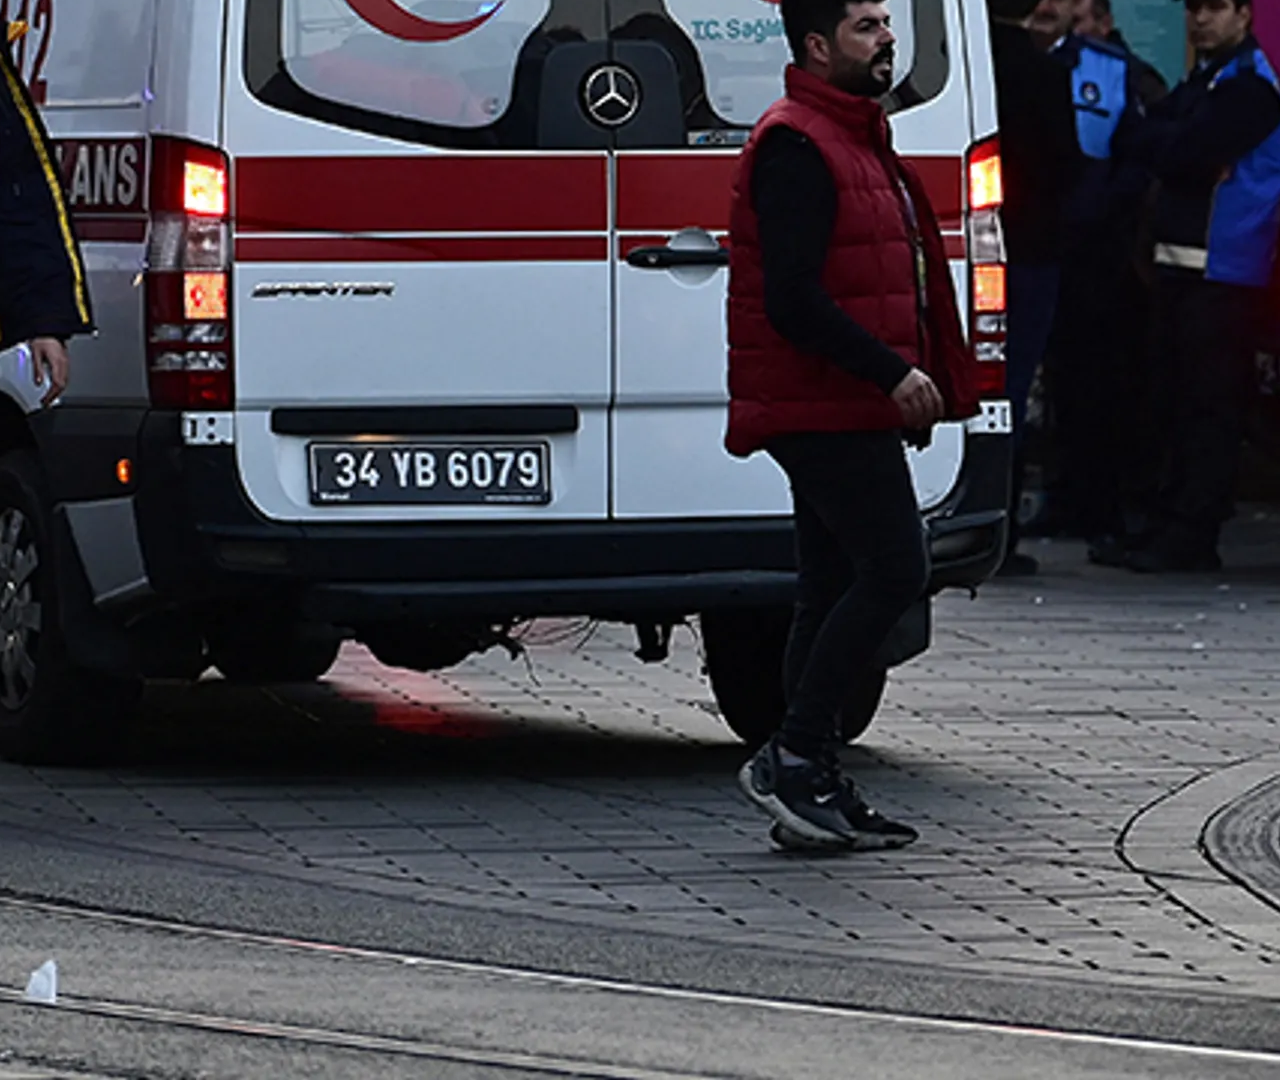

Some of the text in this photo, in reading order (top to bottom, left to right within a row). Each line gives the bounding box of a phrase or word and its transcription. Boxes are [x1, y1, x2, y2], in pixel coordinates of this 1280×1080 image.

[334, 452, 539, 488] 34 YB 6079
